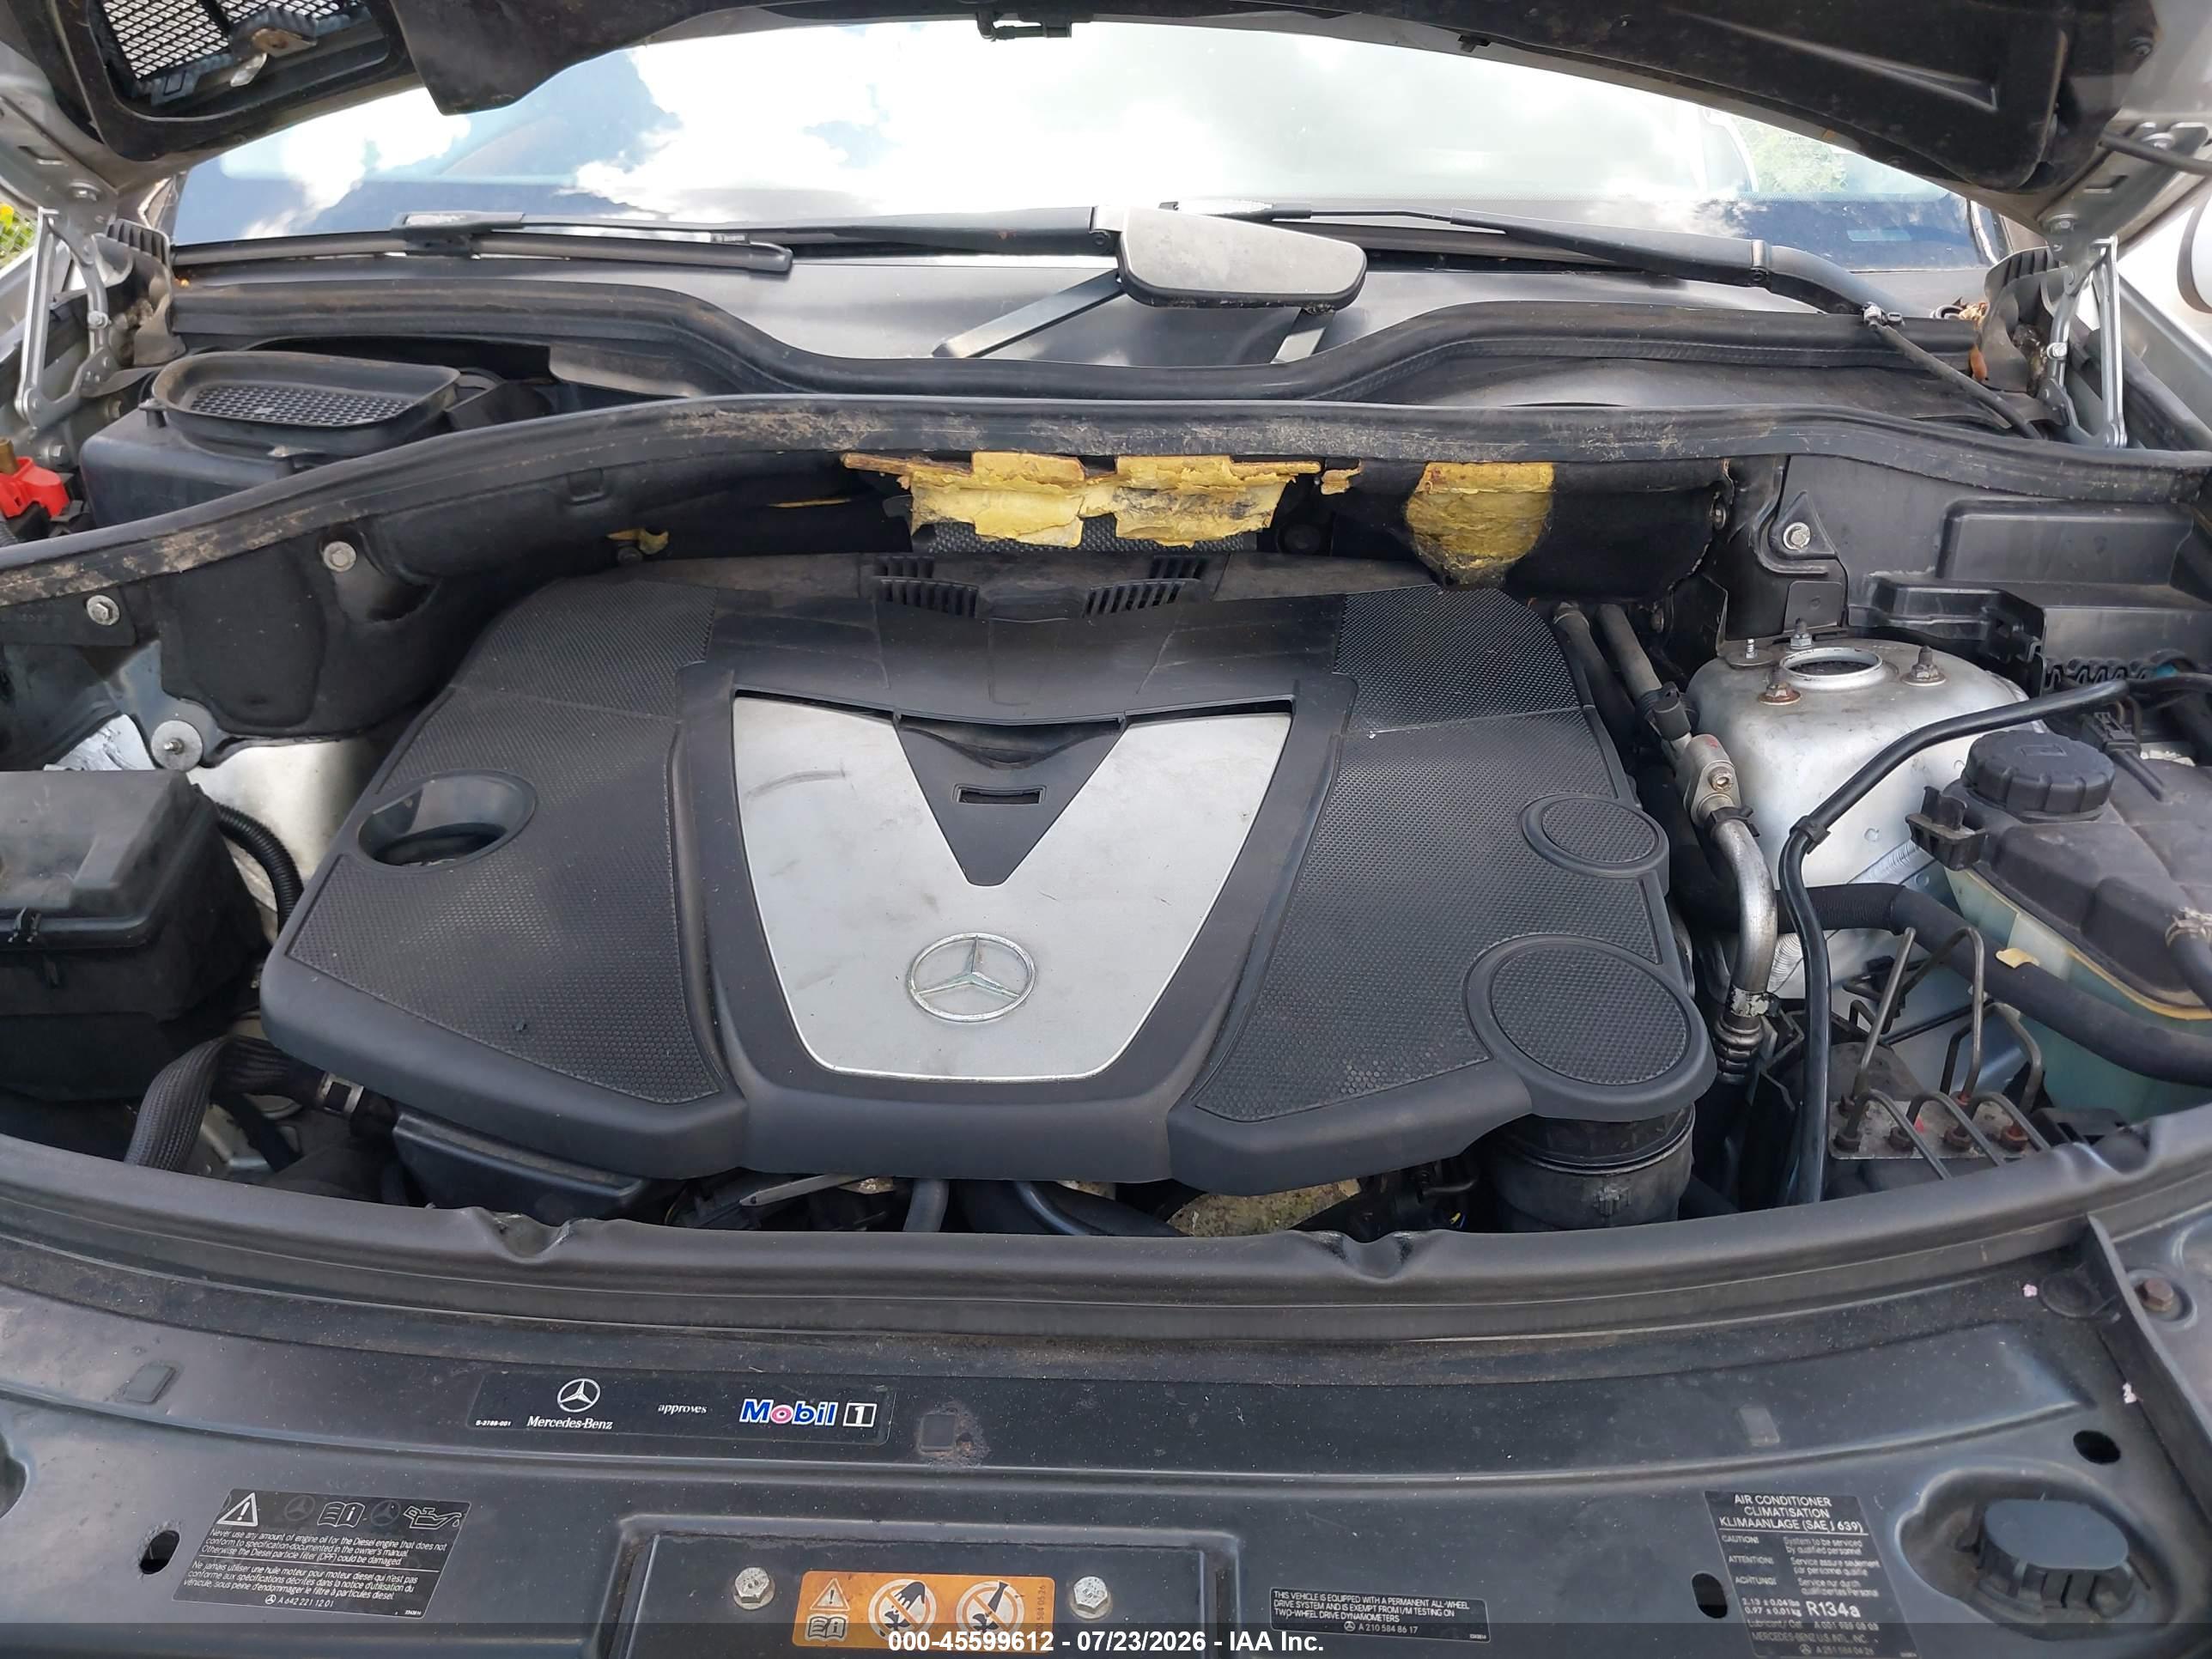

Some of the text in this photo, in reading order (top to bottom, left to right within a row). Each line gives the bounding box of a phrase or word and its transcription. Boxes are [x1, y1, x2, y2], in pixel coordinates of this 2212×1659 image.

[657, 1401, 708, 1415] approves
[738, 1398, 839, 1427] Mobil
[526, 1415, 614, 1431] Mercedes-Benz
[1734, 1493, 1833, 1508] AIR CONDITIONER
[1743, 1506, 1832, 1519] CLIMATISATION
[1718, 1516, 1802, 1531] KLIMAANLAGE
[1802, 1519, 1828, 1533] (SAE
[1837, 1521, 1864, 1534] 639)
[205, 1538, 236, 1547] conform
[333, 1545, 342, 1553] in
[341, 1545, 354, 1554] the
[354, 1547, 382, 1556] owner's
[210, 1528, 230, 1537] Never
[258, 1533, 287, 1541] amount
[285, 1533, 295, 1542] of
[295, 1535, 319, 1544] engine
[319, 1535, 329, 1544] oil
[328, 1535, 339, 1545] for
[340, 1536, 353, 1546] the
[352, 1537, 375, 1547] Diesel
[375, 1540, 399, 1549] engine
[399, 1540, 415, 1549] that
[416, 1541, 434, 1551] does
[434, 1542, 448, 1552] not
[201, 1545, 238, 1555] Otherwise
[238, 1547, 251, 1556] the
[250, 1548, 272, 1558] Diesel
[270, 1549, 300, 1559] particle
[299, 1551, 318, 1560] filter
[317, 1552, 338, 1562] (DPF)
[337, 1553, 357, 1563] could
[356, 1554, 368, 1564] be
[191, 1560, 204, 1570] Ne
[203, 1562, 228, 1571] jamais
[227, 1563, 252, 1572] utiliser
[264, 1565, 282, 1575] huile
[281, 1567, 307, 1577] moteur
[306, 1571, 326, 1581] pour
[325, 1570, 353, 1580] moteur
[352, 1571, 375, 1581] diesel
[374, 1573, 386, 1583] qui
[386, 1574, 404, 1583] n'est
[403, 1575, 419, 1584] pas
[187, 1570, 416, 1593] conforme aux spécifications décrites dans la notice d'utilisation du
[213, 1580, 232, 1589] sous
[252, 1583, 305, 1595] d'endommager
[304, 1585, 313, 1595] le
[312, 1586, 331, 1596] filtre
[335, 1589, 372, 1599] particules
[283, 1597, 300, 1606] 642
[298, 1598, 313, 1607] 221
[314, 1599, 325, 1607] 12
[324, 1600, 335, 1608] 01
[1273, 1590, 1290, 1600] THIS
[1290, 1592, 1319, 1601] VEHICLE
[1327, 1594, 1361, 1604] EQUIPPED
[1361, 1595, 1381, 1605] WITH
[1381, 1596, 1388, 1605] A
[1387, 1597, 1431, 1607] PERMANENT
[1431, 1599, 1471, 1610] ALL-WHEEL
[1273, 1599, 1295, 1608] DRIVE
[1295, 1601, 1325, 1610] SYSTEM
[1325, 1602, 1341, 1611] AND
[1340, 1603, 1349, 1612] IS
[1349, 1604, 1378, 1613] EXEMPT
[1377, 1606, 1401, 1614] FROM
[1413, 1607, 1443, 1617] TESTING
[1443, 1608, 1456, 1618] ON
[1274, 1607, 1401, 1623] TWO-WHEEL DRIVE DYNAMOMETERS
[1805, 1600, 1863, 1619] R134a
[1358, 1623, 1419, 1634] A 210 584 86 17
